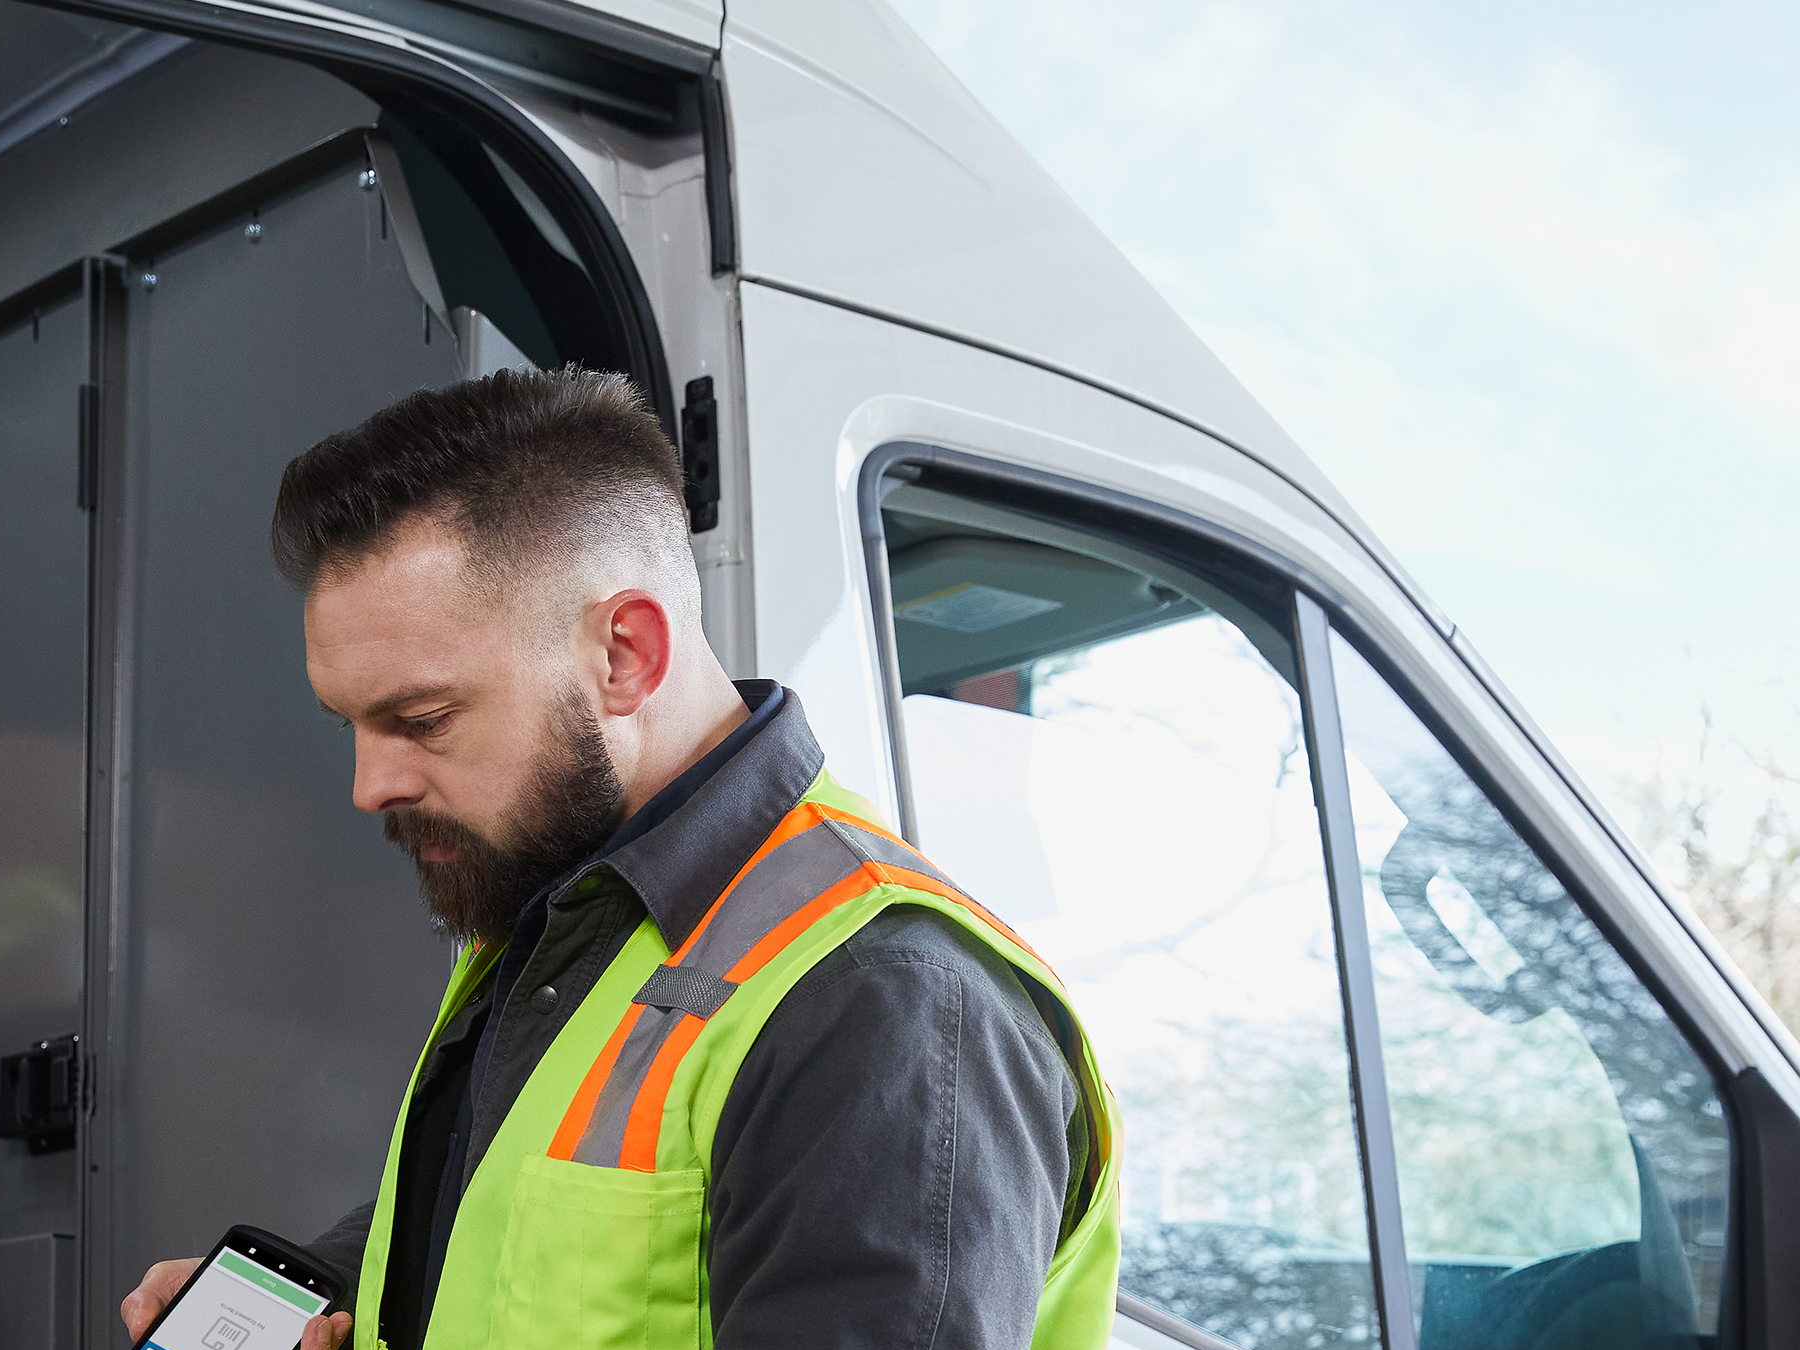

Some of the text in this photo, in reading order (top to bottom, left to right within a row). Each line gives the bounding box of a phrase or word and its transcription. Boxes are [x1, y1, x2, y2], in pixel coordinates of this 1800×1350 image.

[262, 1277, 277, 1289] Done
[220, 1302, 236, 1314] Items
[234, 1310, 258, 1326] Scanned
